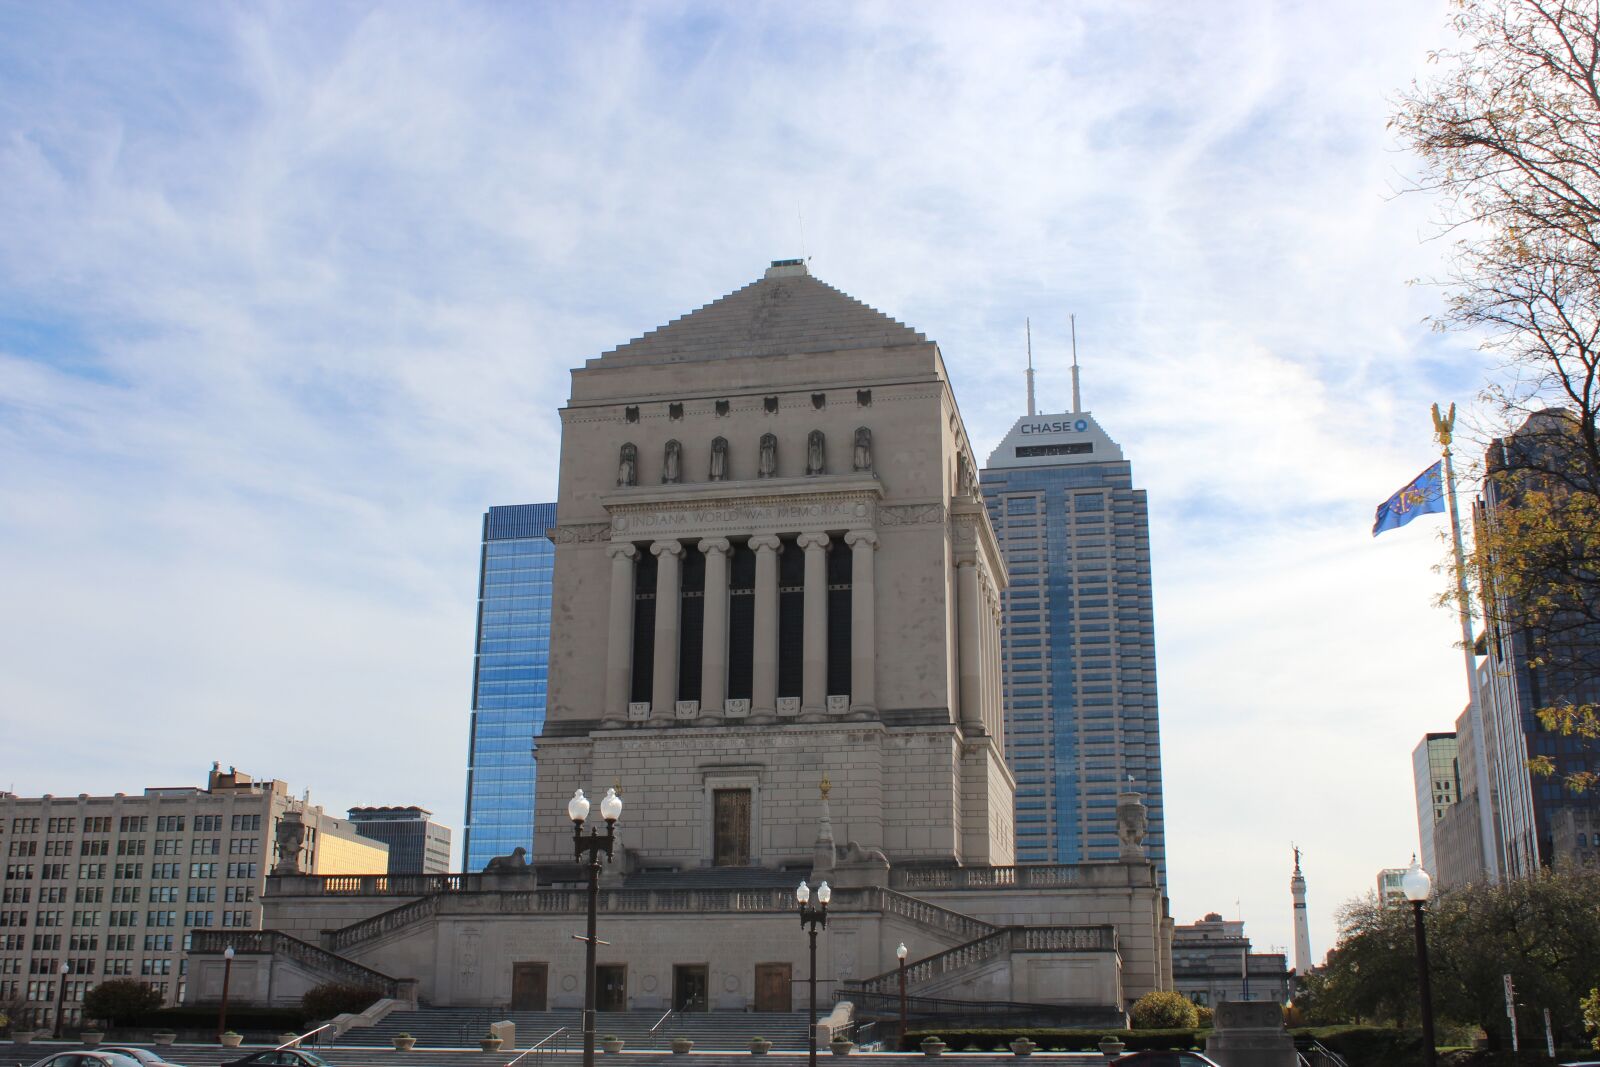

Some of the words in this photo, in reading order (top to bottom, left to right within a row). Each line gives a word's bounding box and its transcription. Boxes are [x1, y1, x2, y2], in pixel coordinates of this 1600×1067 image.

[1020, 422, 1072, 434] CHASE
[632, 513, 687, 528] INDIANA
[695, 509, 739, 523] WORLD
[744, 508, 772, 520] WAR
[778, 505, 849, 518] MEMORIAL
